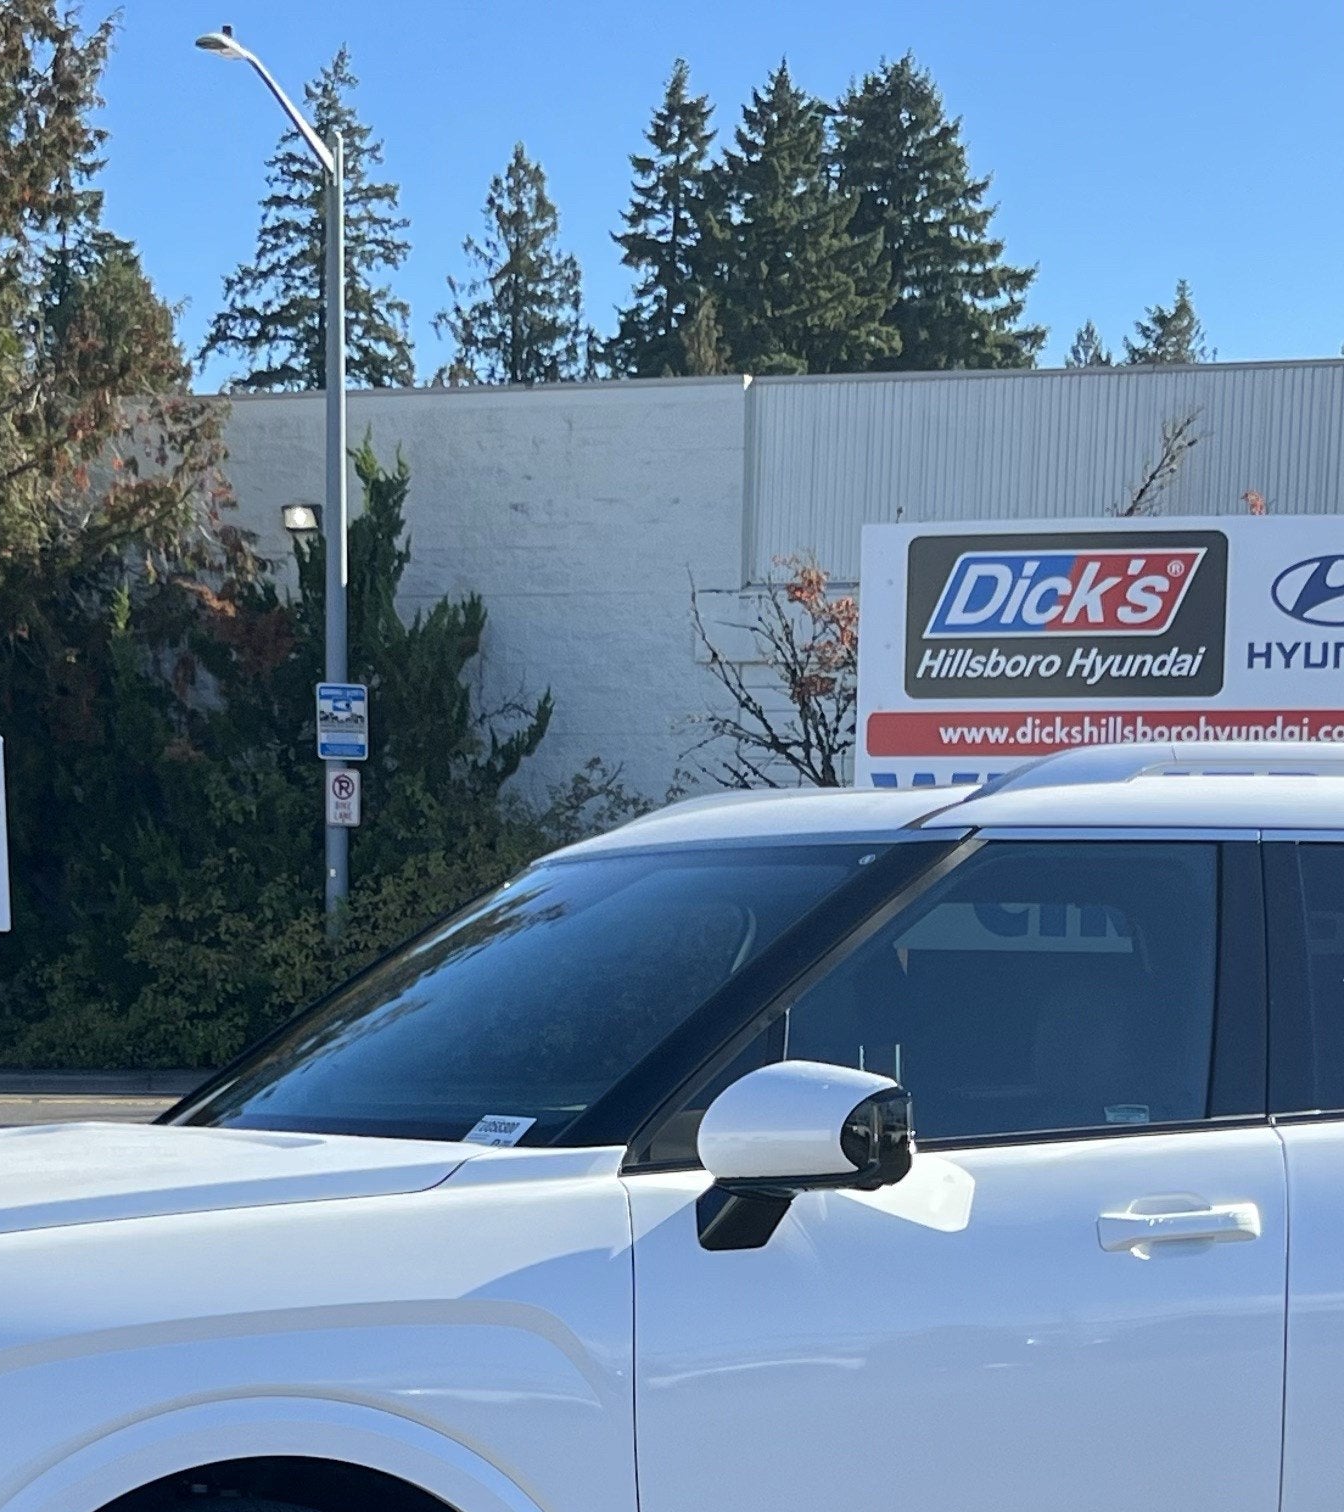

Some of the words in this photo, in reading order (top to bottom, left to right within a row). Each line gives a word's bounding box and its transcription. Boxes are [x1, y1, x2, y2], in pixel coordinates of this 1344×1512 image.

[945, 559, 1170, 625] Dick's
[916, 648, 1061, 679] Hillsboro
[1066, 646, 1207, 685] Hyundai
